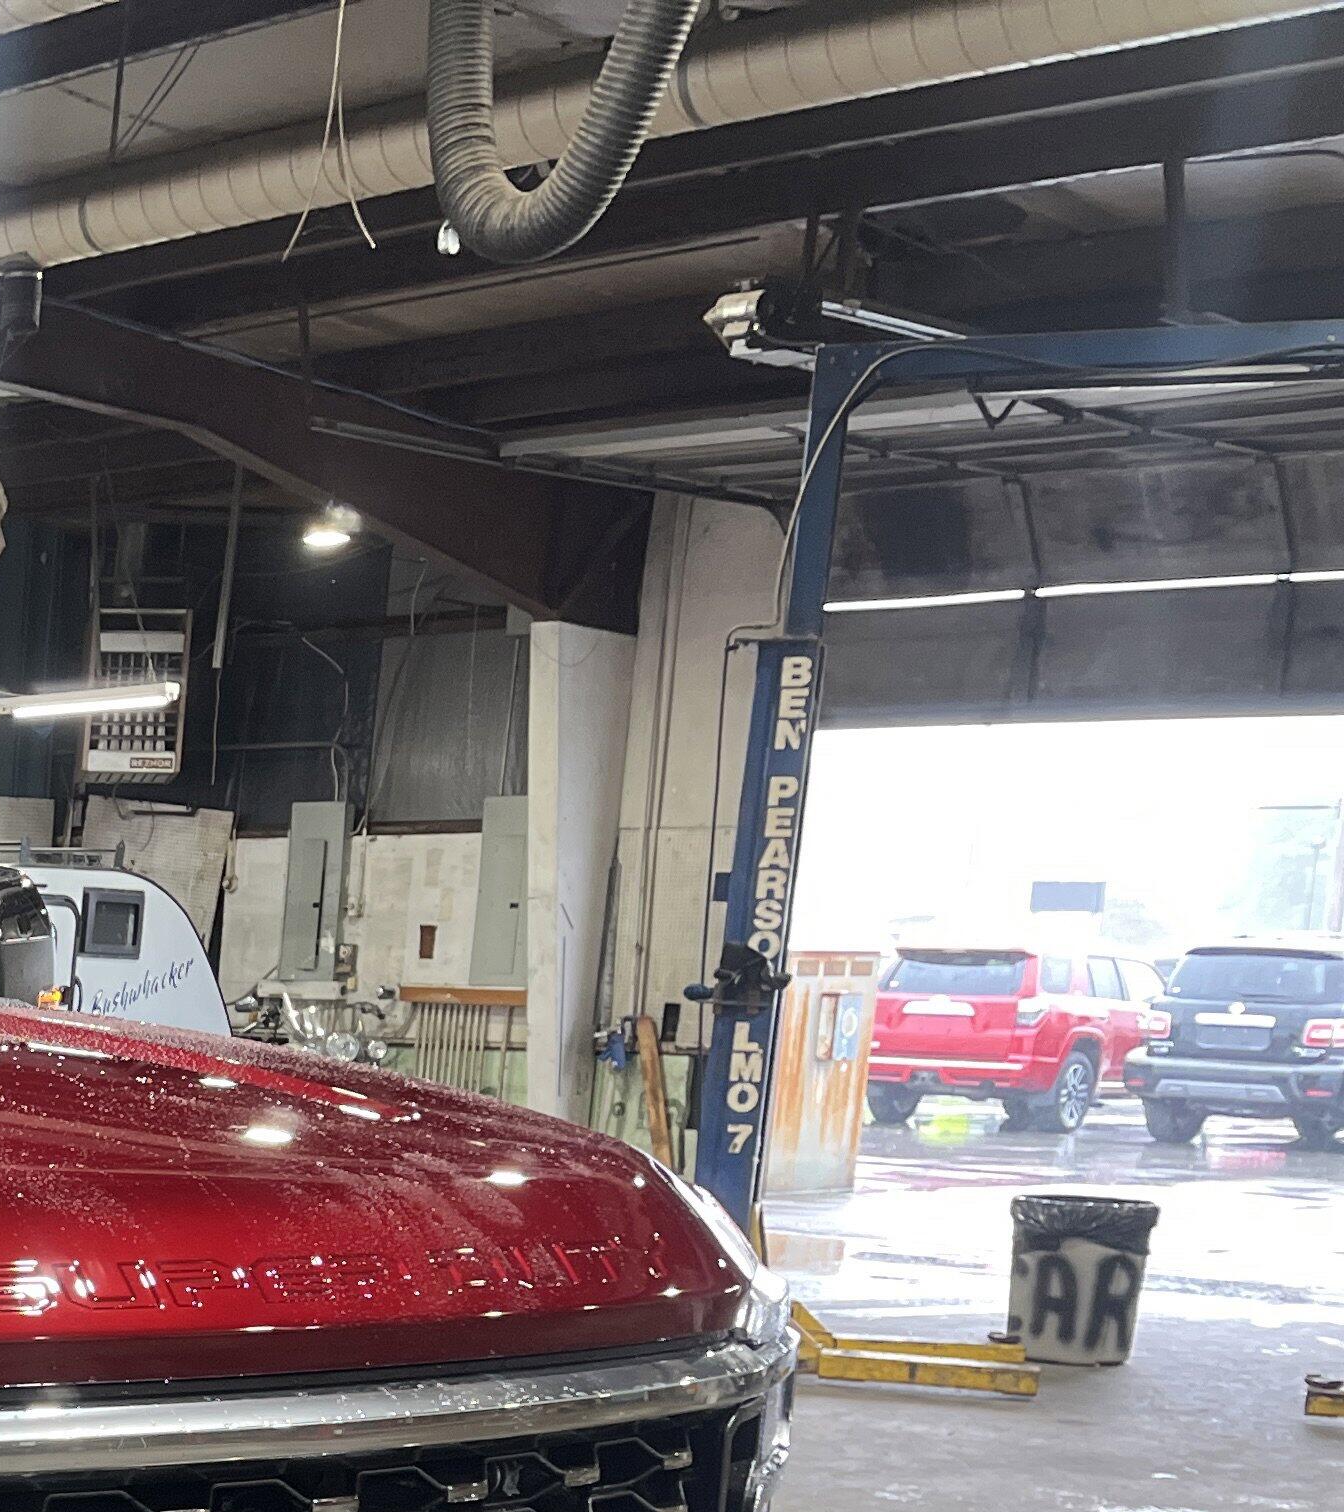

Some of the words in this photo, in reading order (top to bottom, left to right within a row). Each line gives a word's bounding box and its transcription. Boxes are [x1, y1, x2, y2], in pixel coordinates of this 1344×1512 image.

[773, 655, 813, 751] BEN
[747, 775, 799, 970] PEARSO
[92, 958, 194, 1014] Bushwhacker
